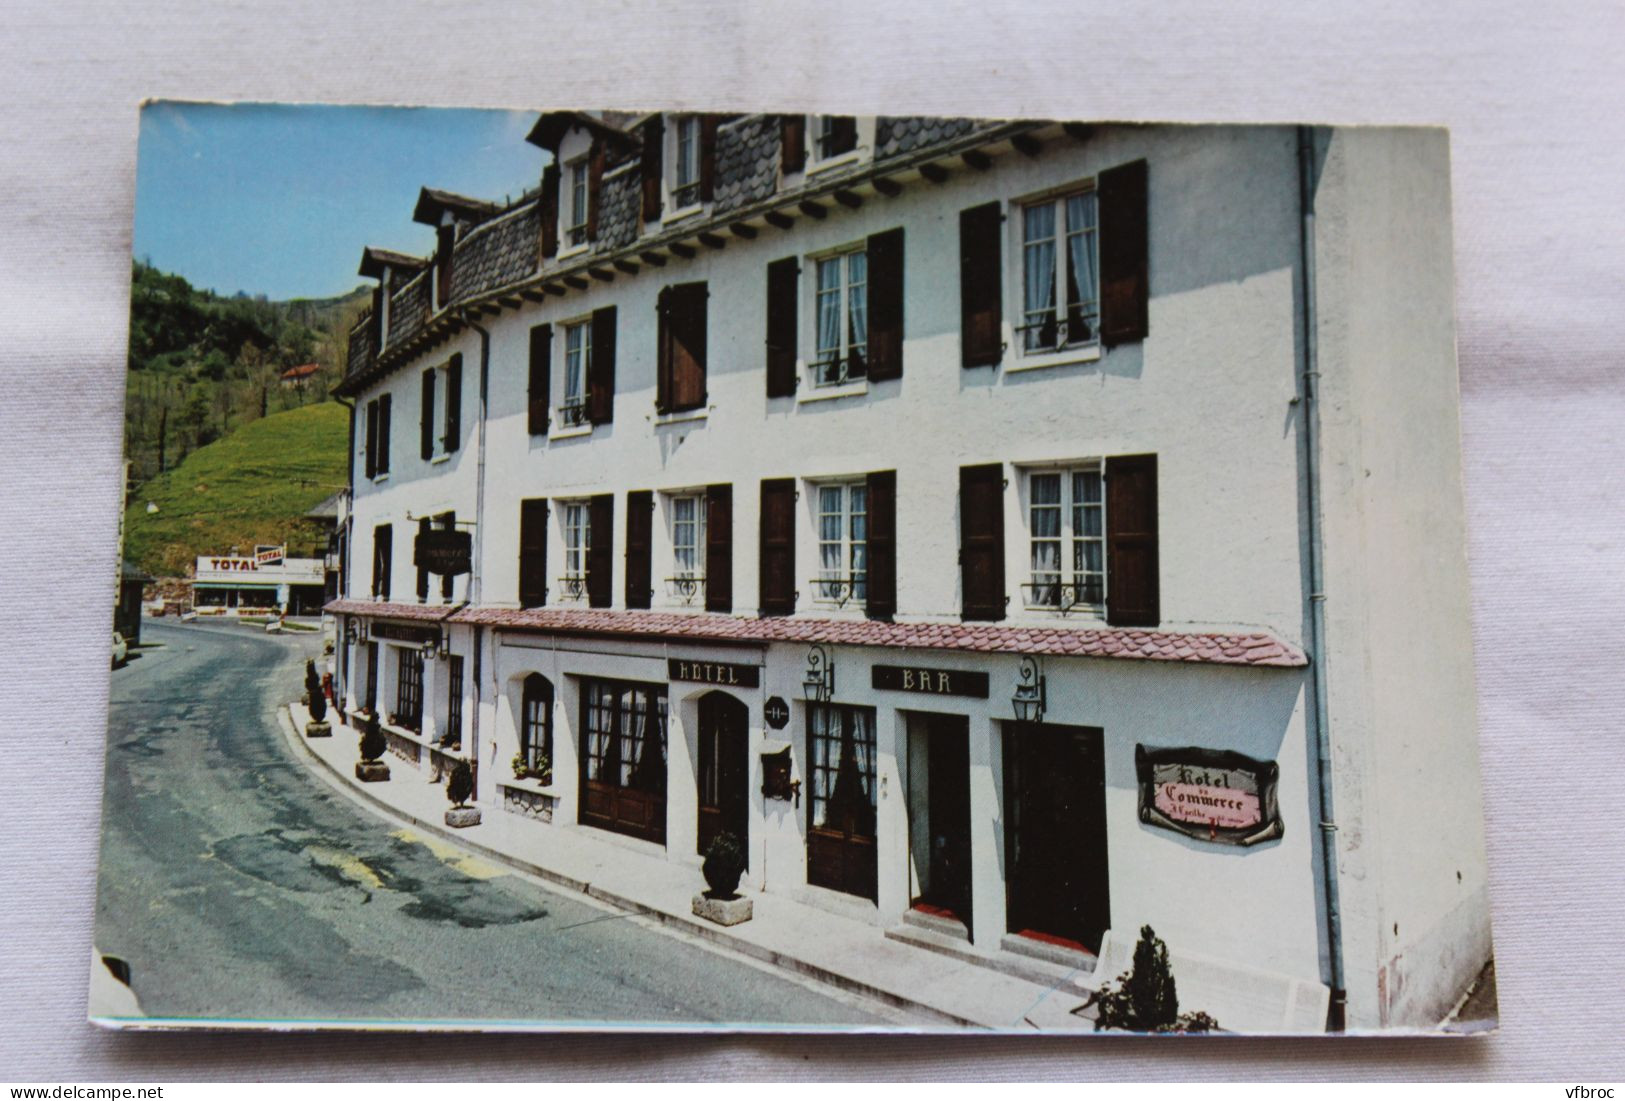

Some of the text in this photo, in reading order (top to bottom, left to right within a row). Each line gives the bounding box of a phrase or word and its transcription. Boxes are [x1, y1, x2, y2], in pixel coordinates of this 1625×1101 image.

[211, 560, 258, 571] TOTAL
[258, 550, 282, 561] TOTAL
[679, 662, 739, 684] HOTEL
[903, 669, 951, 692] BAR
[1165, 785, 1243, 809] Commerce
